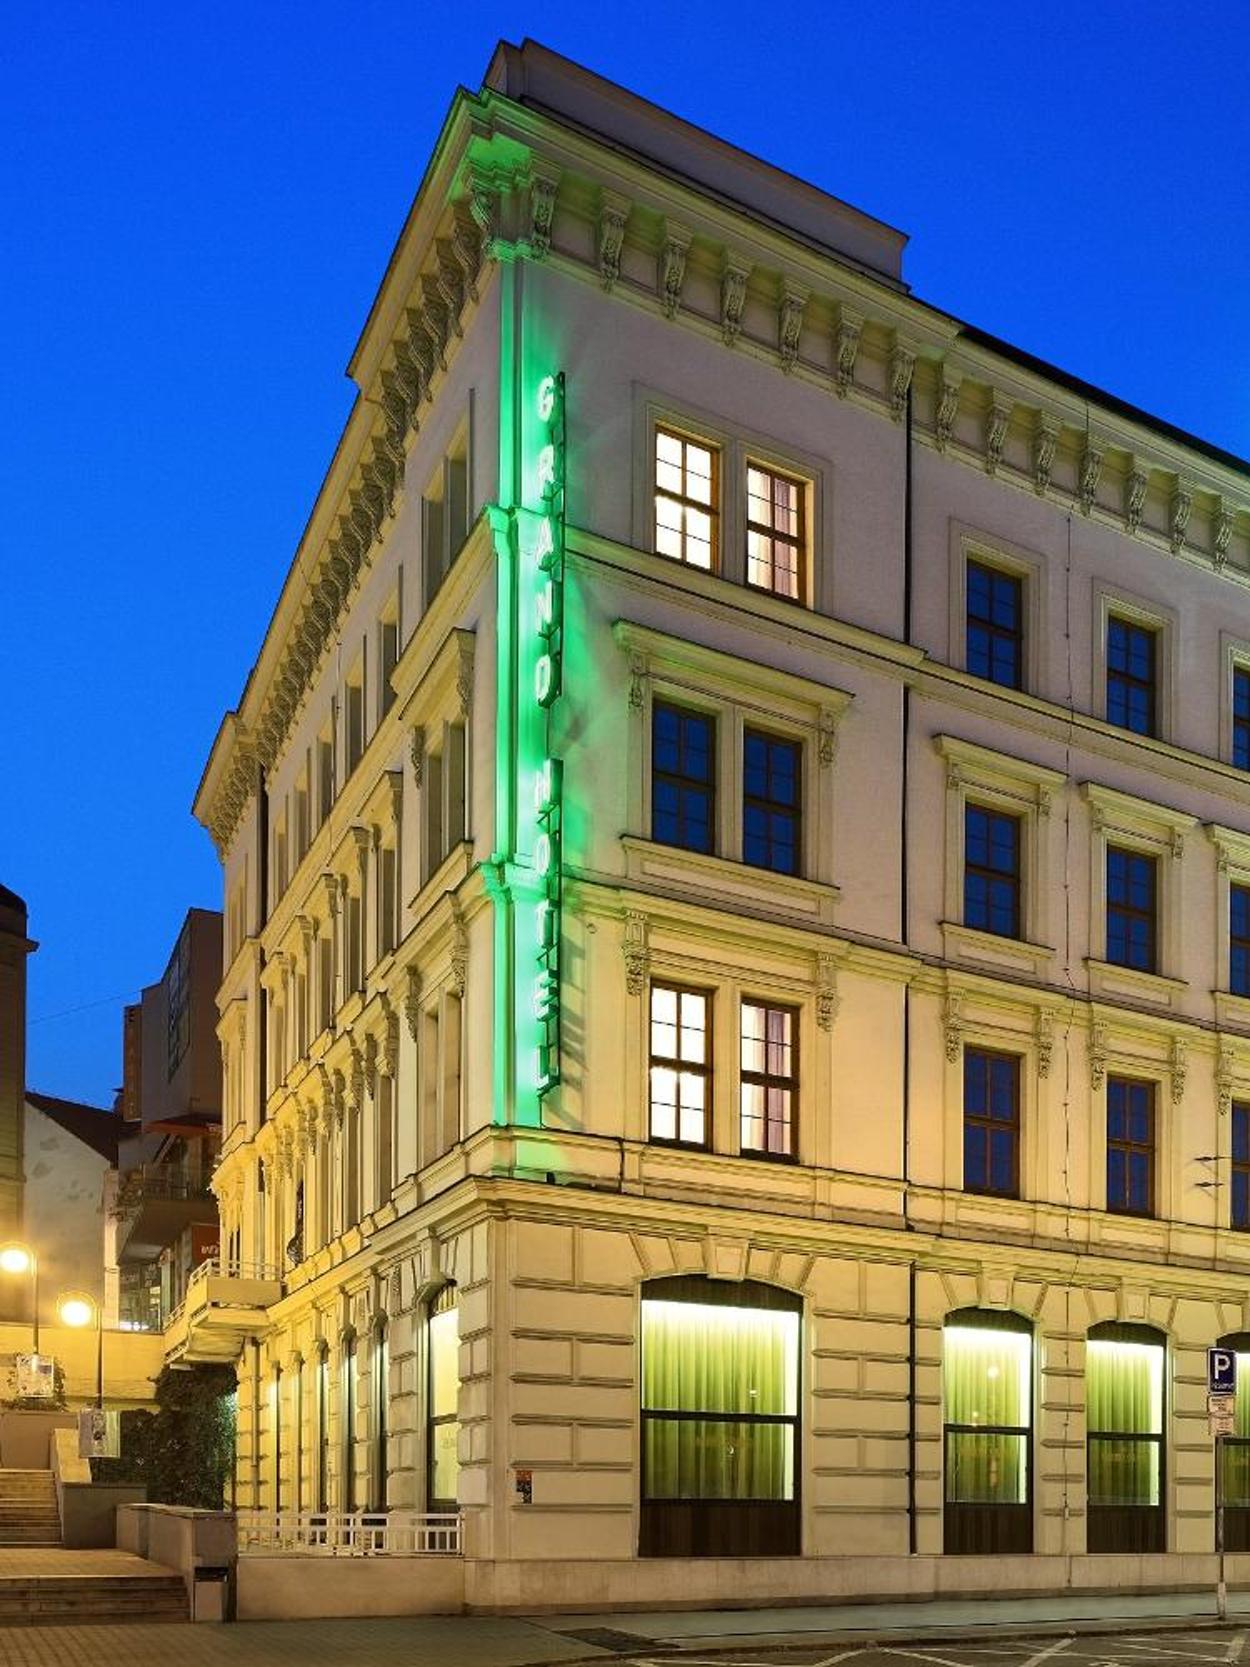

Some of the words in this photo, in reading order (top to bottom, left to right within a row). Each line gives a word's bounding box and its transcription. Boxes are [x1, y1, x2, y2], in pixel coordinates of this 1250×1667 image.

[534, 370, 562, 706] GRAND
[532, 760, 562, 1097] HOTEL
[1214, 1353, 1231, 1380] P
